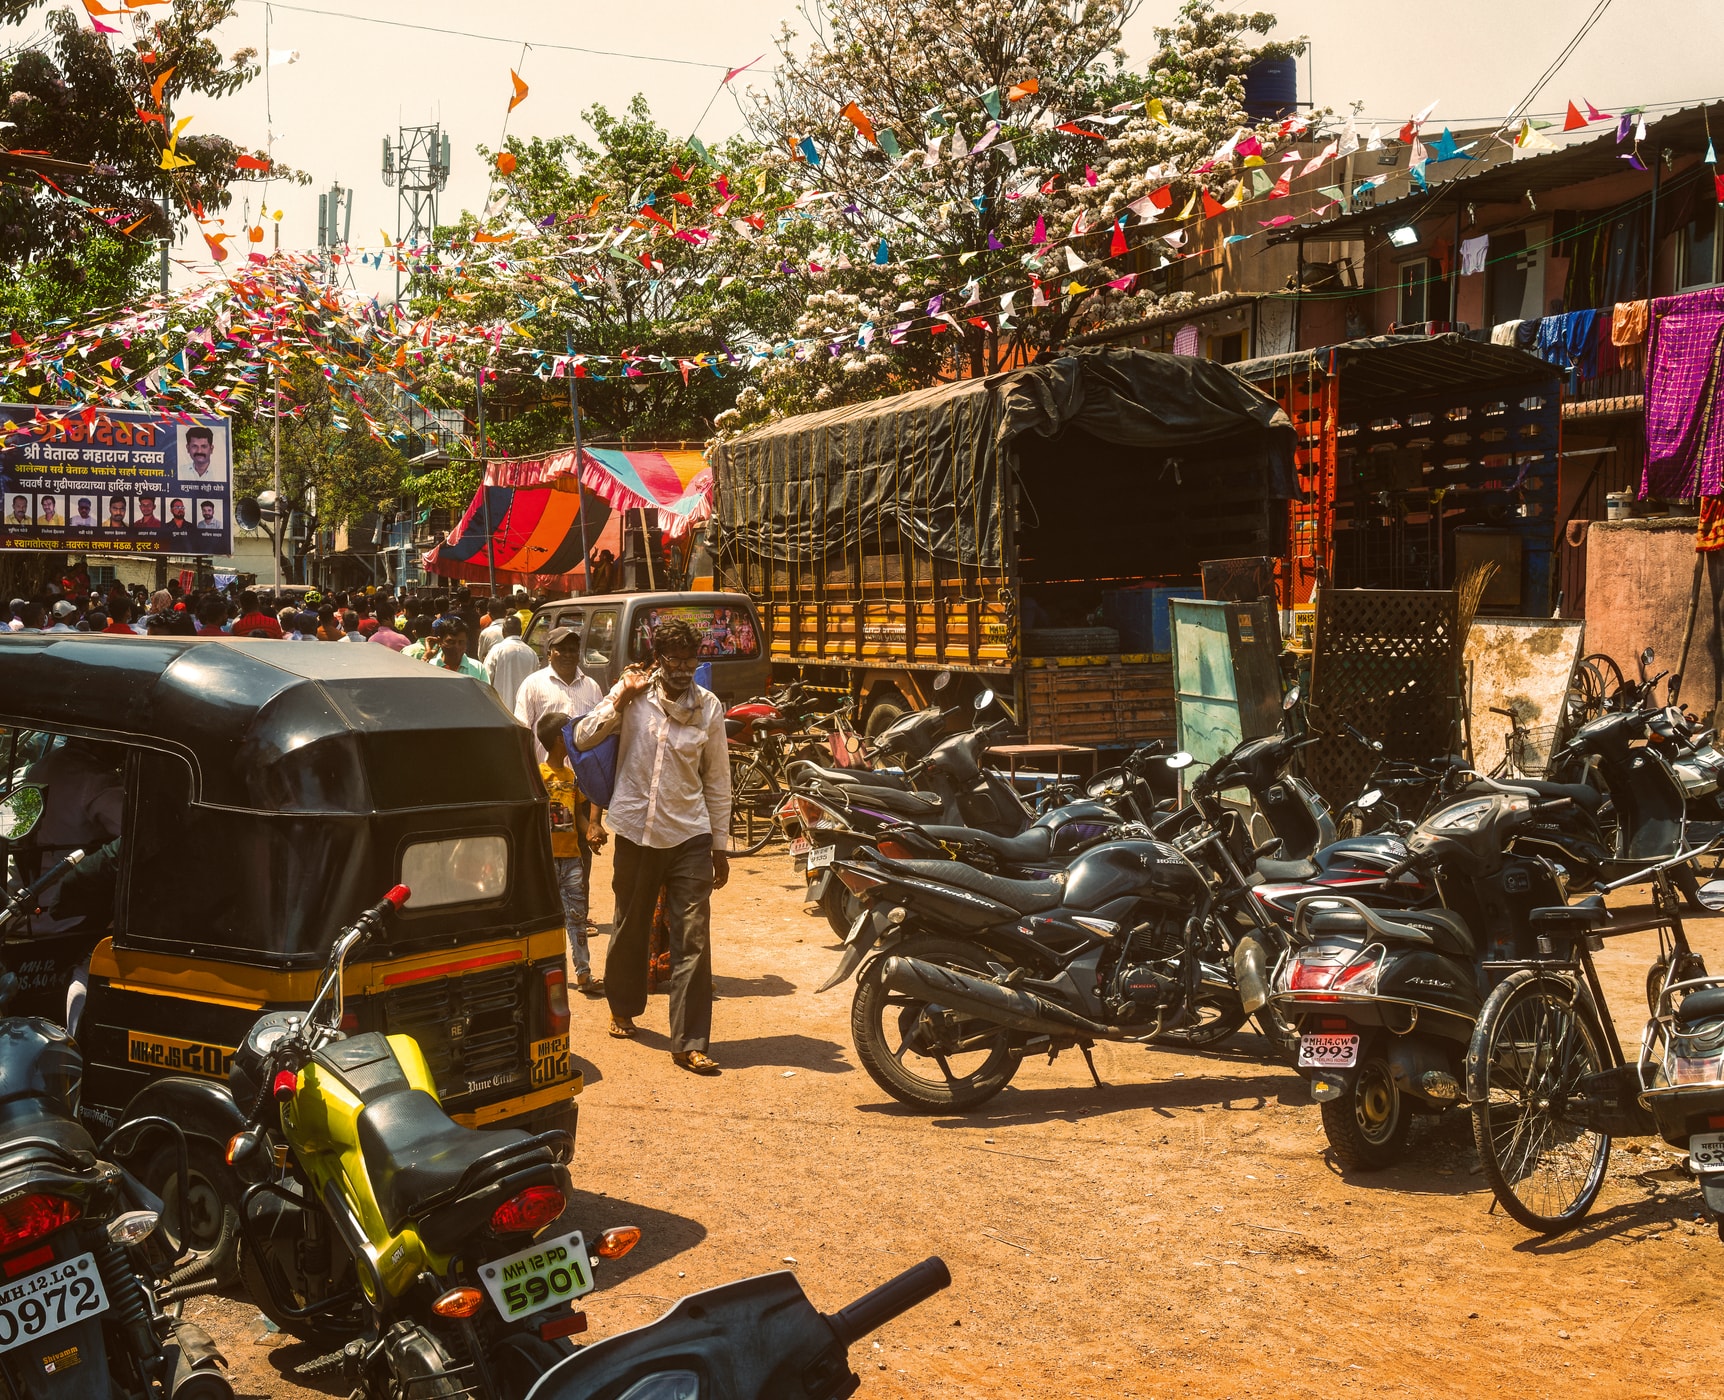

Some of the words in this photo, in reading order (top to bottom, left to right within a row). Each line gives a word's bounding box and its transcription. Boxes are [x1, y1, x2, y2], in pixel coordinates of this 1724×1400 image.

[23, 442, 41, 460] श्री
[43, 443, 80, 461] वेताळ
[82, 448, 130, 464] महाराज
[132, 450, 165, 464] उत्सव
[15, 462, 48, 474] आलेल्या
[49, 462, 65, 474] सर्व
[65, 463, 89, 475] वेताळ
[90, 464, 117, 476] भक्तांचे
[118, 465, 137, 477] सहर्ष
[19, 476, 43, 488] नववर्ष
[44, 479, 51, 488] व
[108, 479, 132, 492] हार्दिक
[451, 1025, 463, 1037] RE
[1302, 1045, 1354, 1059] 8993
[468, 1079, 492, 1093] Pune
[503, 1262, 527, 1281] MH
[529, 1255, 545, 1271] 12
[546, 1246, 568, 1264] PD
[503, 1261, 586, 1314] 5901
[0, 1276, 101, 1346] 0972
